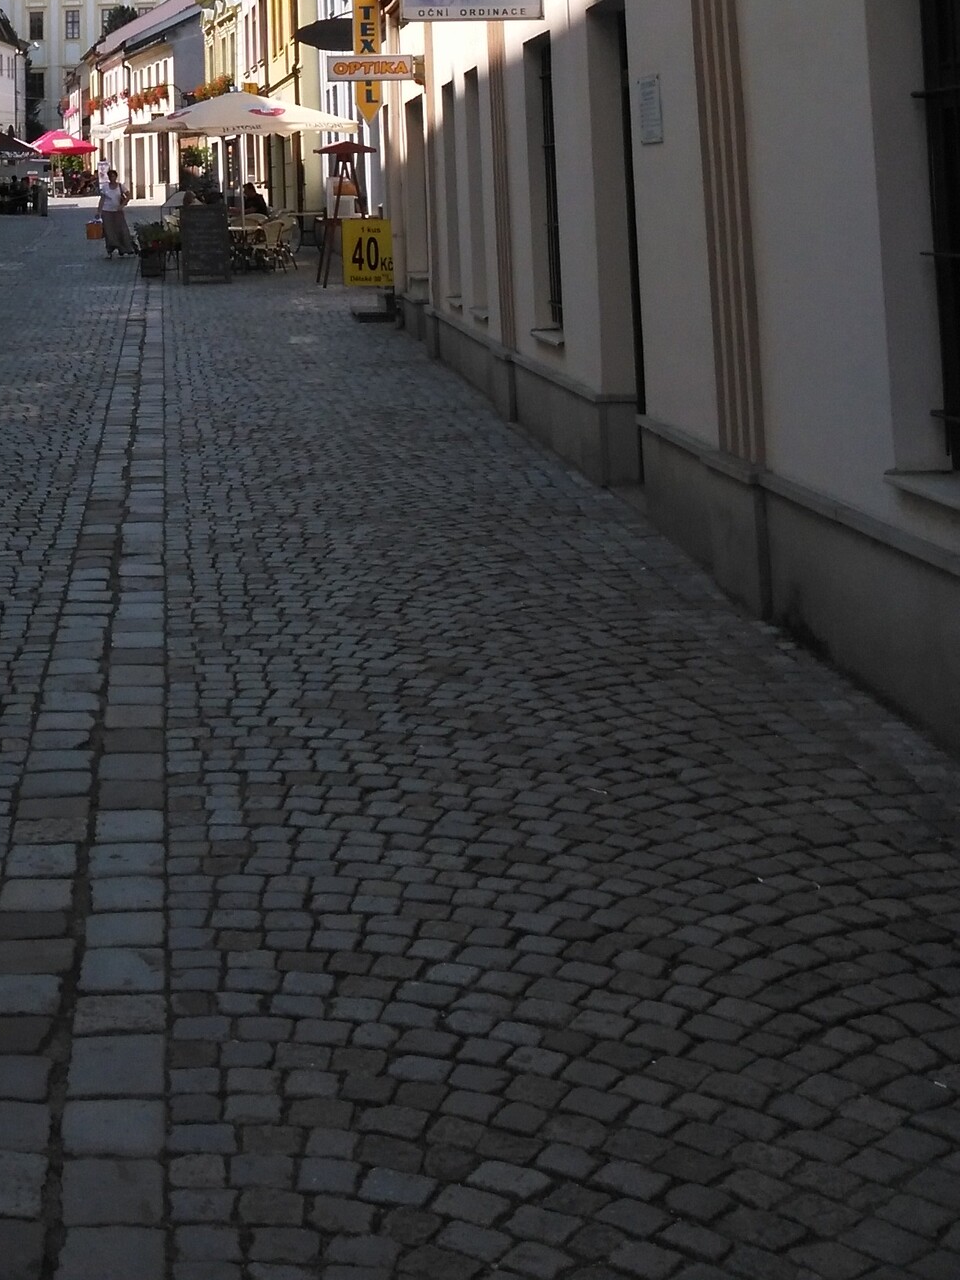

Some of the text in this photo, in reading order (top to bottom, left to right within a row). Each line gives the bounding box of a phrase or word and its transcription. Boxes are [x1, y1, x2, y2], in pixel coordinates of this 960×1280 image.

[418, 6, 527, 17] OČNÍ ORDINACE
[359, 5, 378, 103] TEXL
[333, 61, 409, 75] OPTIKA
[352, 236, 394, 271] 40 Kč
